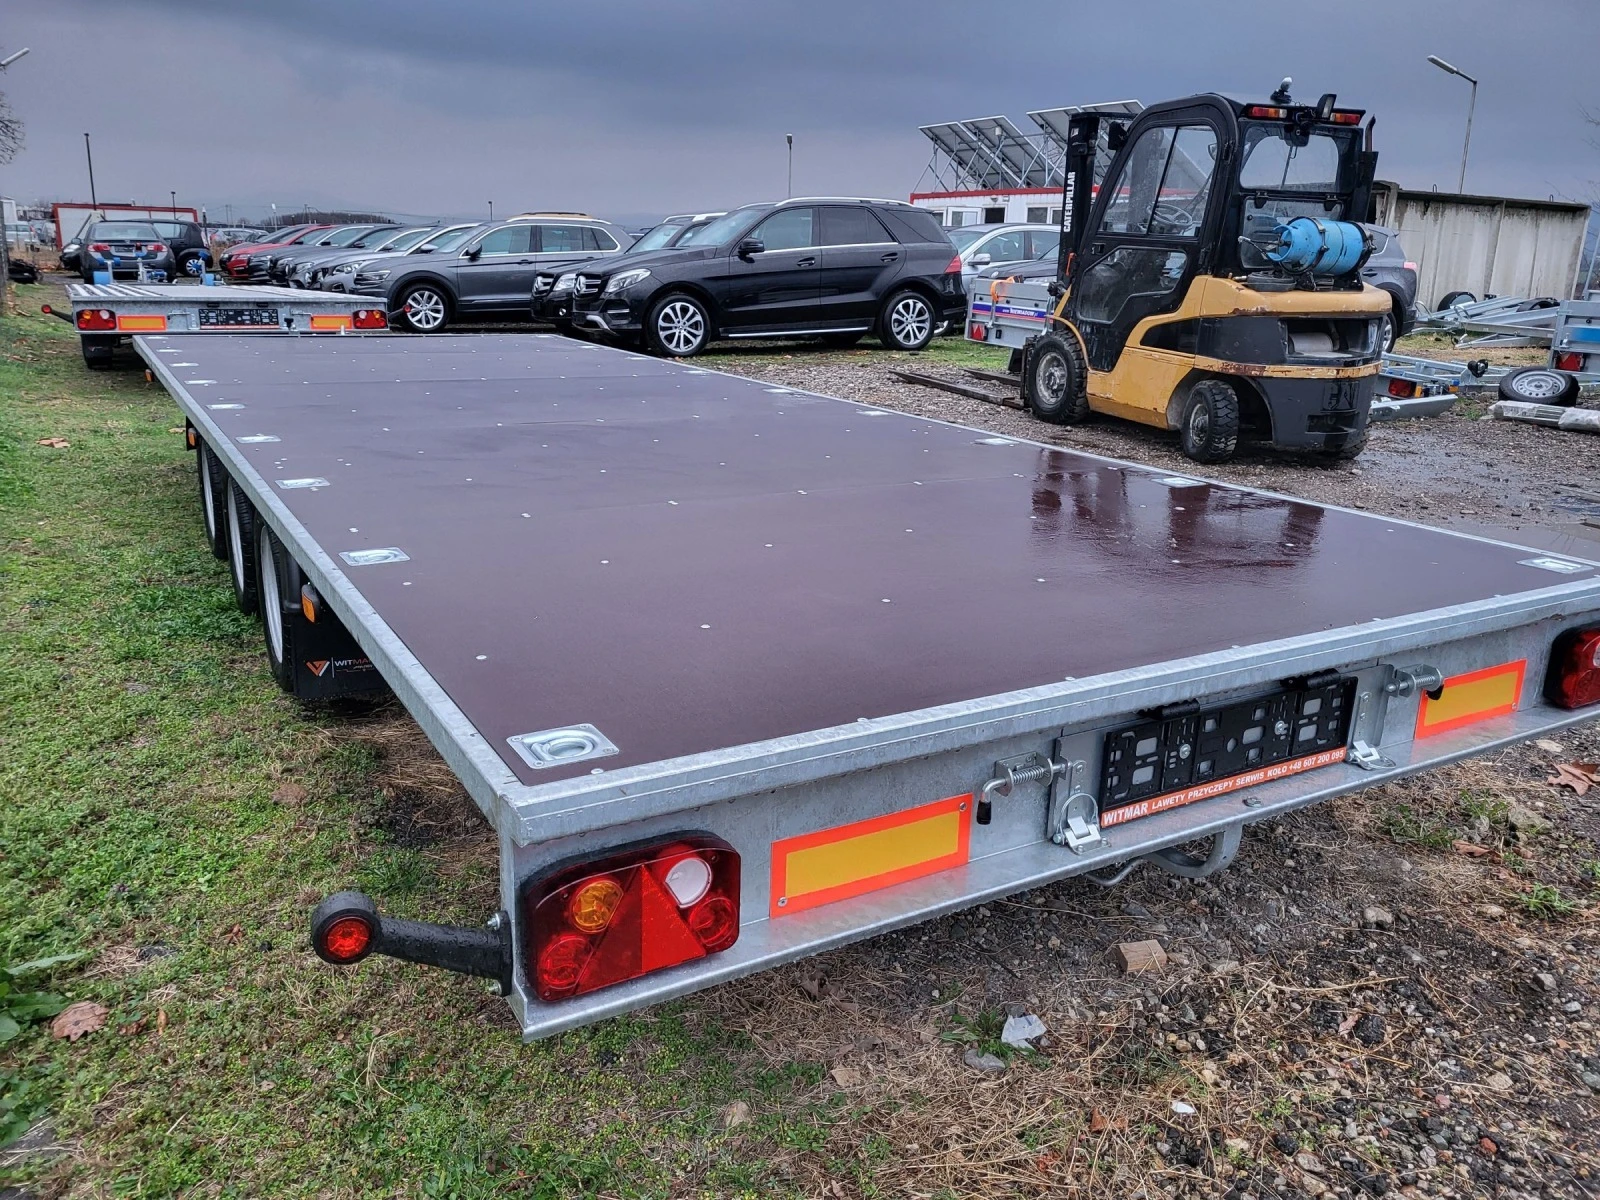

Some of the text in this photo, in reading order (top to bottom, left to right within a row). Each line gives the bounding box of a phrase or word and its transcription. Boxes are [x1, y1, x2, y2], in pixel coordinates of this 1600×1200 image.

[1063, 171, 1076, 233] CATERPILLAR
[1103, 803, 1148, 825] WITMAR
[1152, 794, 1185, 810] LAWETY
[1187, 779, 1235, 799] PRZYCZEPY
[1236, 771, 1265, 786] SERWIS
[1289, 760, 1302, 771] +48
[1304, 756, 1316, 767] 607
[1317, 752, 1330, 764] 200
[1331, 750, 1345, 761] 095
